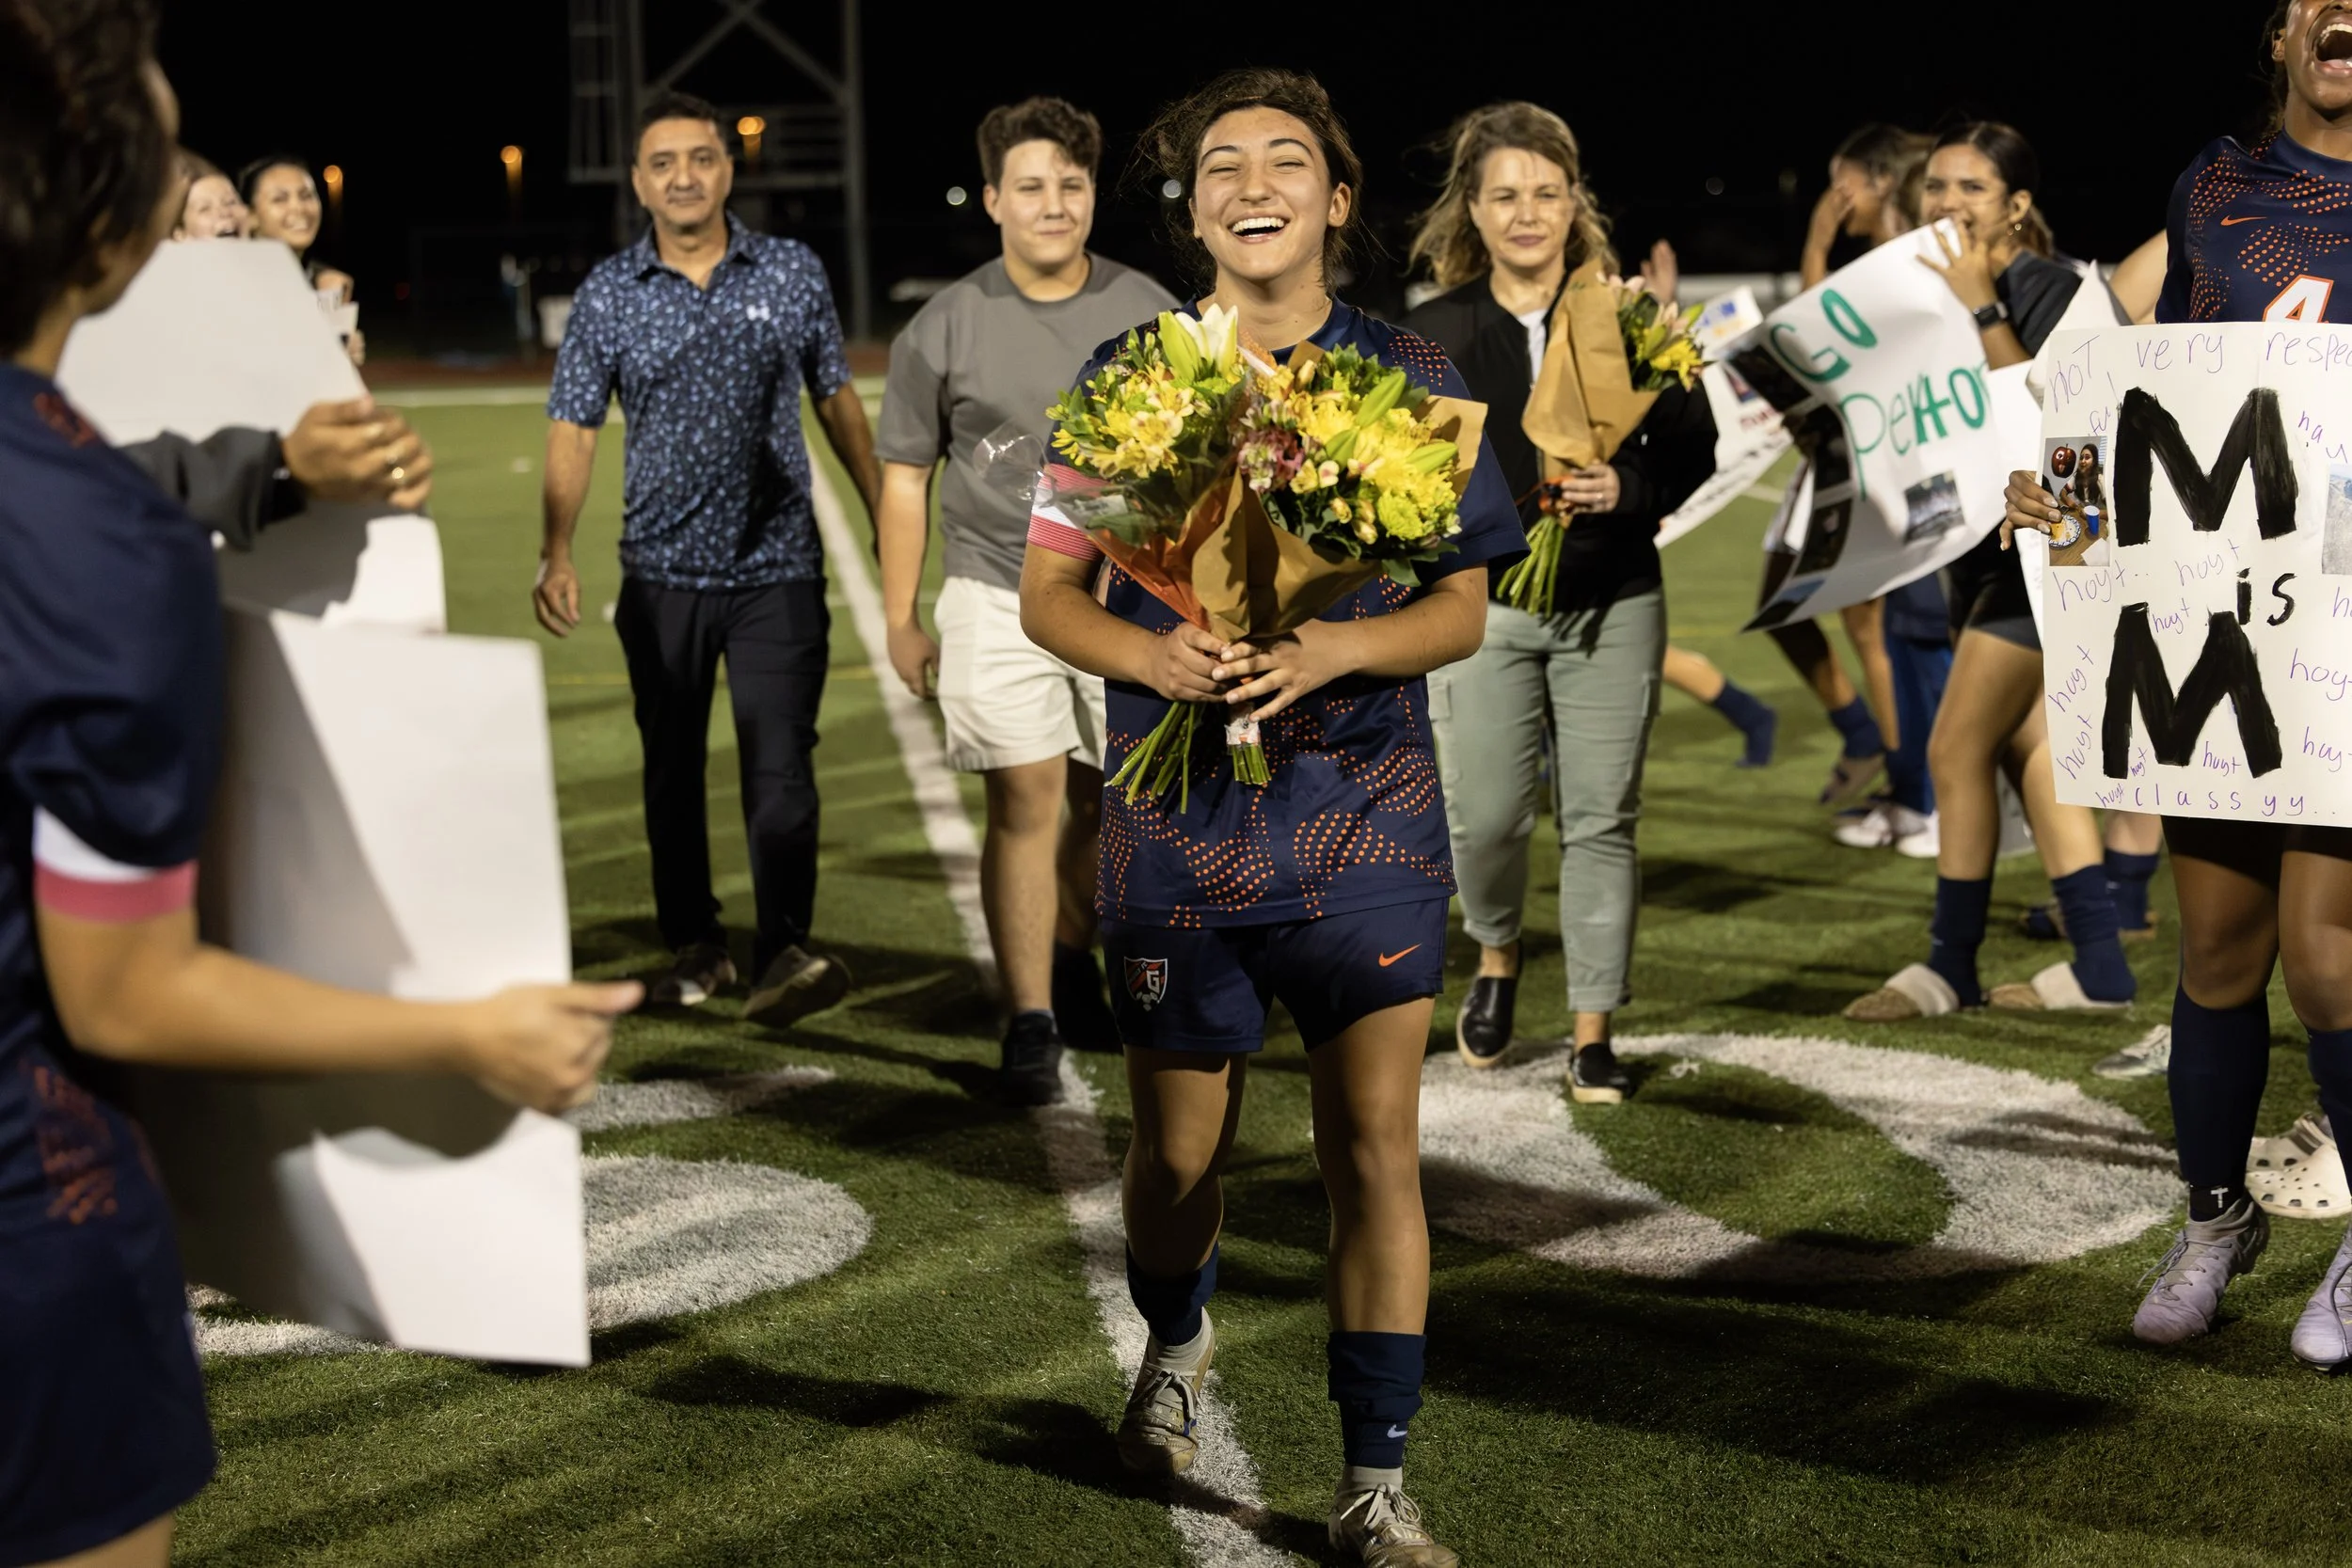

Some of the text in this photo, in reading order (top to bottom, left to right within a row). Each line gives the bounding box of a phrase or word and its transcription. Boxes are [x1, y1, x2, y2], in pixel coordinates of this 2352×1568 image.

[2137, 333, 2223, 373] very
[2114, 387, 2298, 546] M
[2236, 566, 2298, 626] is
[2102, 601, 2282, 779] M
